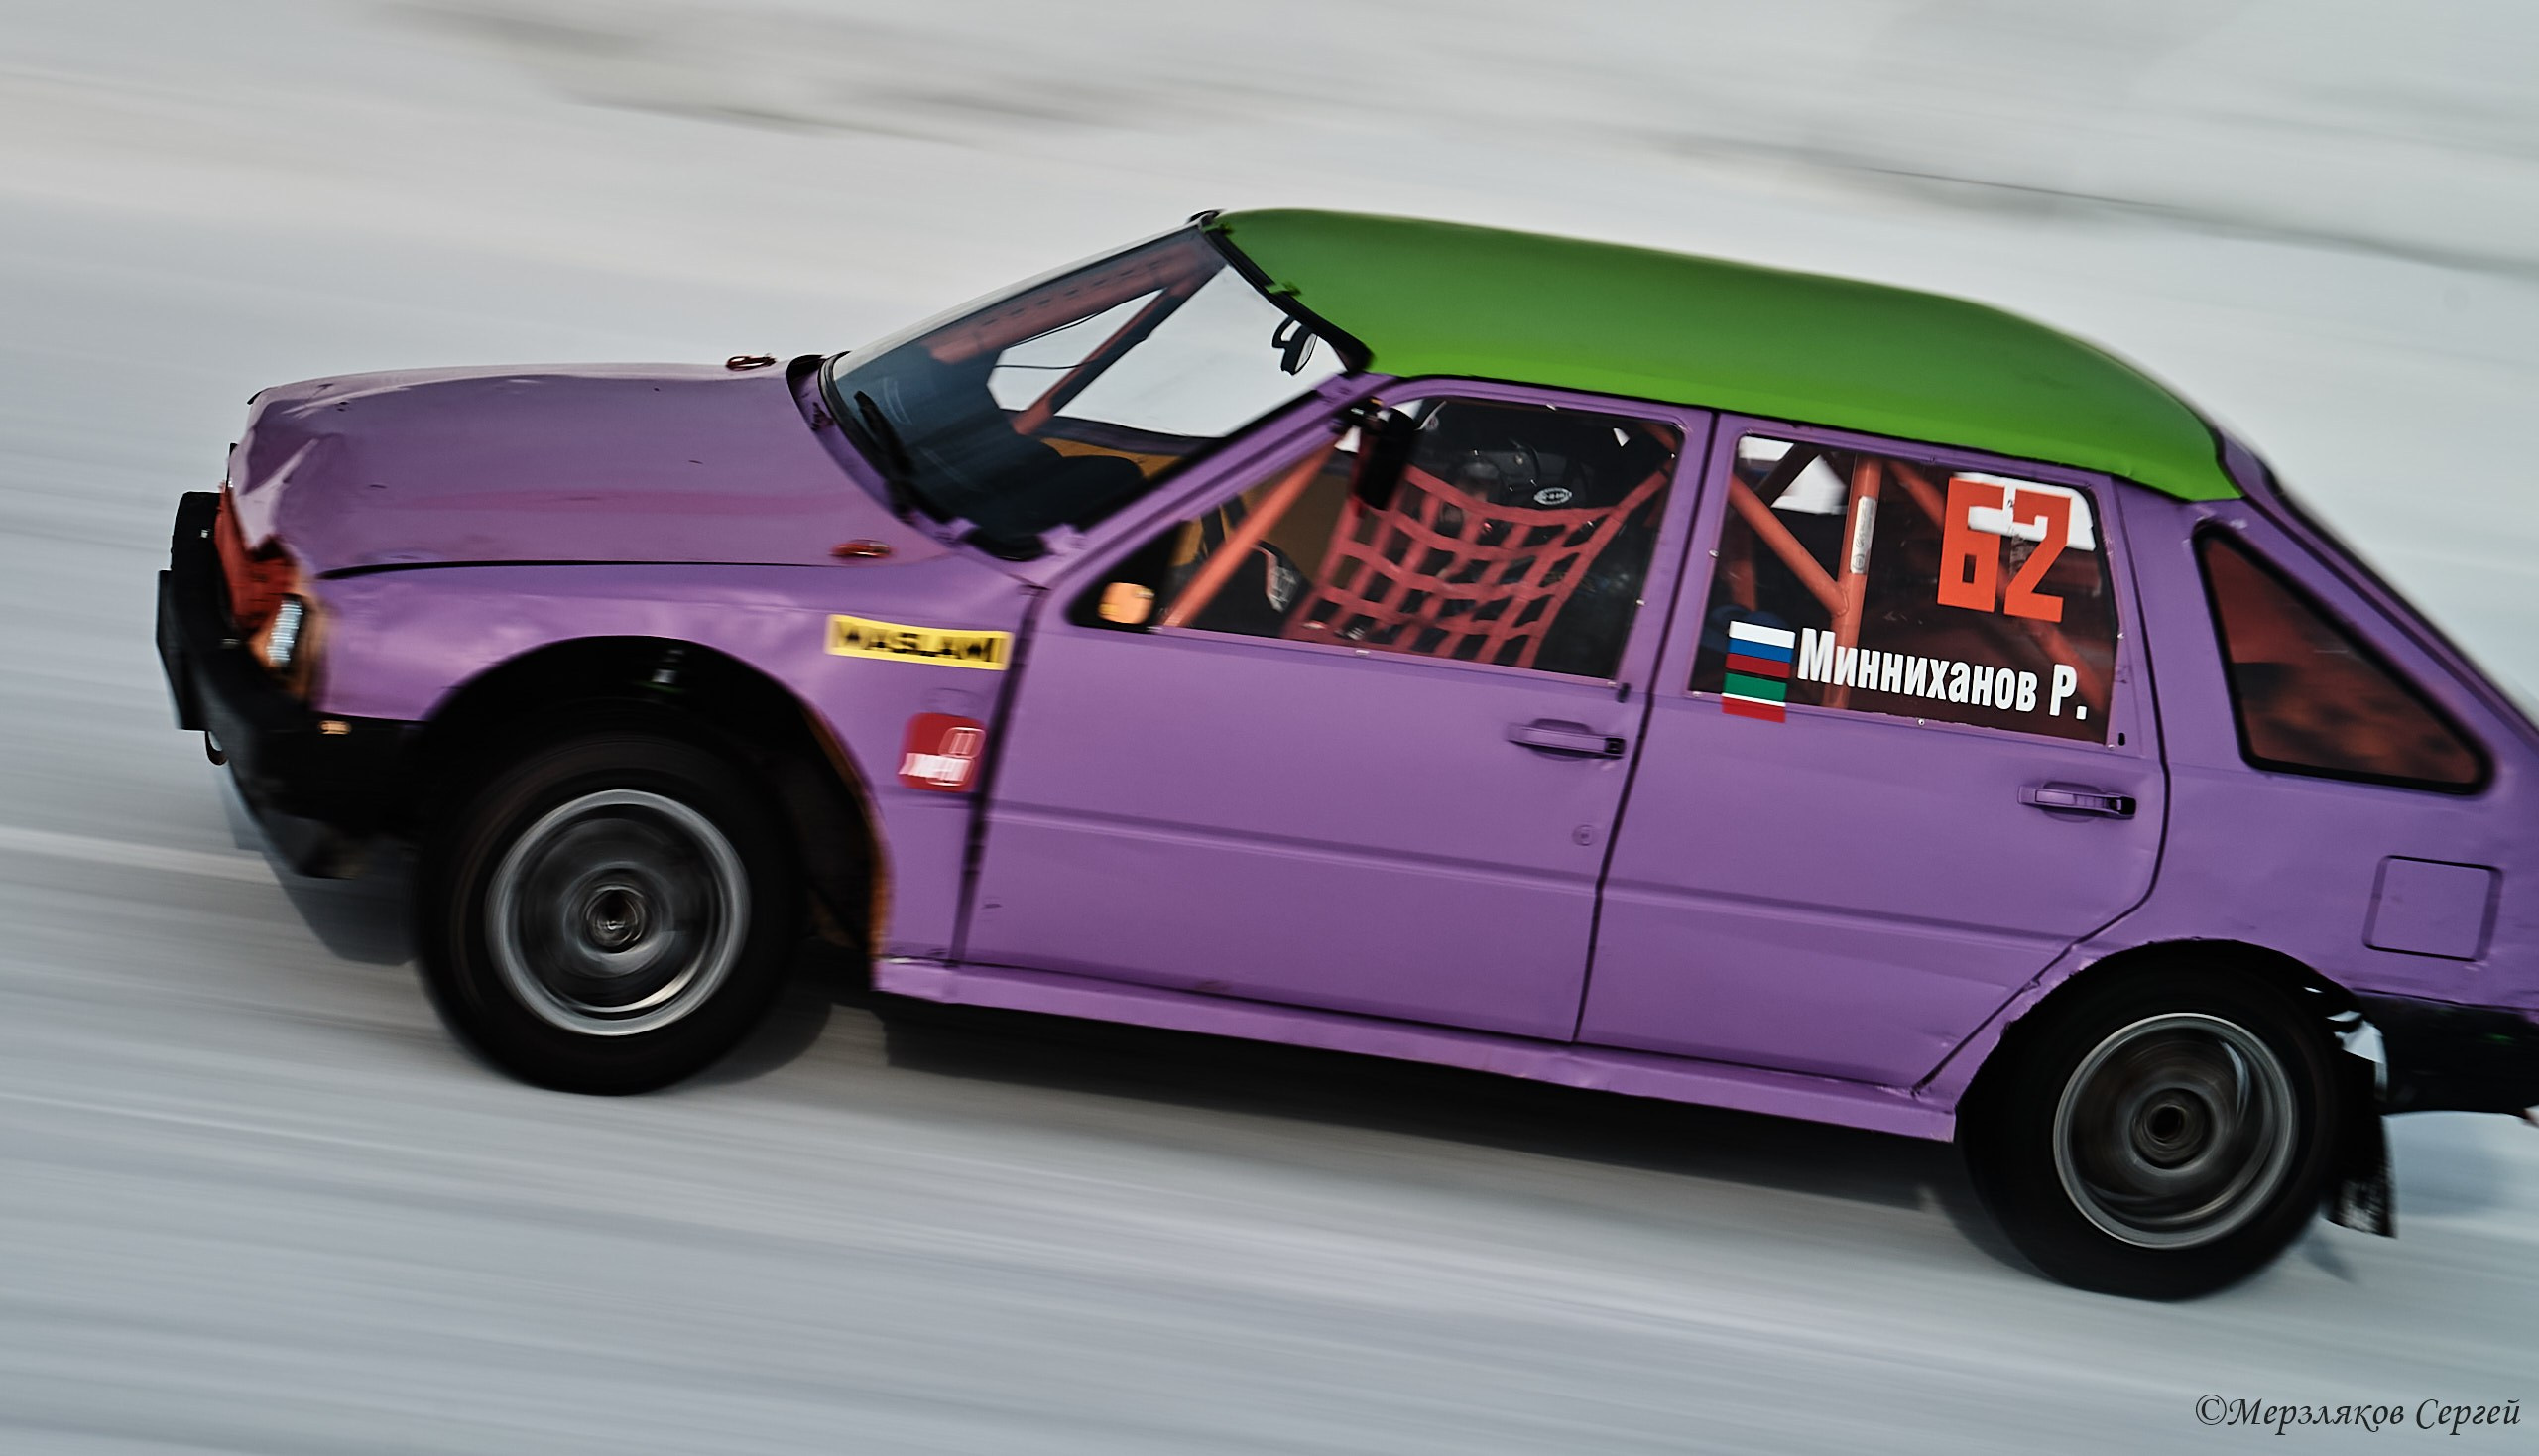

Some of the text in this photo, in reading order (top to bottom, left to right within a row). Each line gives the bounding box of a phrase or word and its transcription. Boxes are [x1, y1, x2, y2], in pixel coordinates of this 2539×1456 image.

[1938, 477, 2072, 623] 62
[1797, 628, 2088, 721] Минниханов Р.
